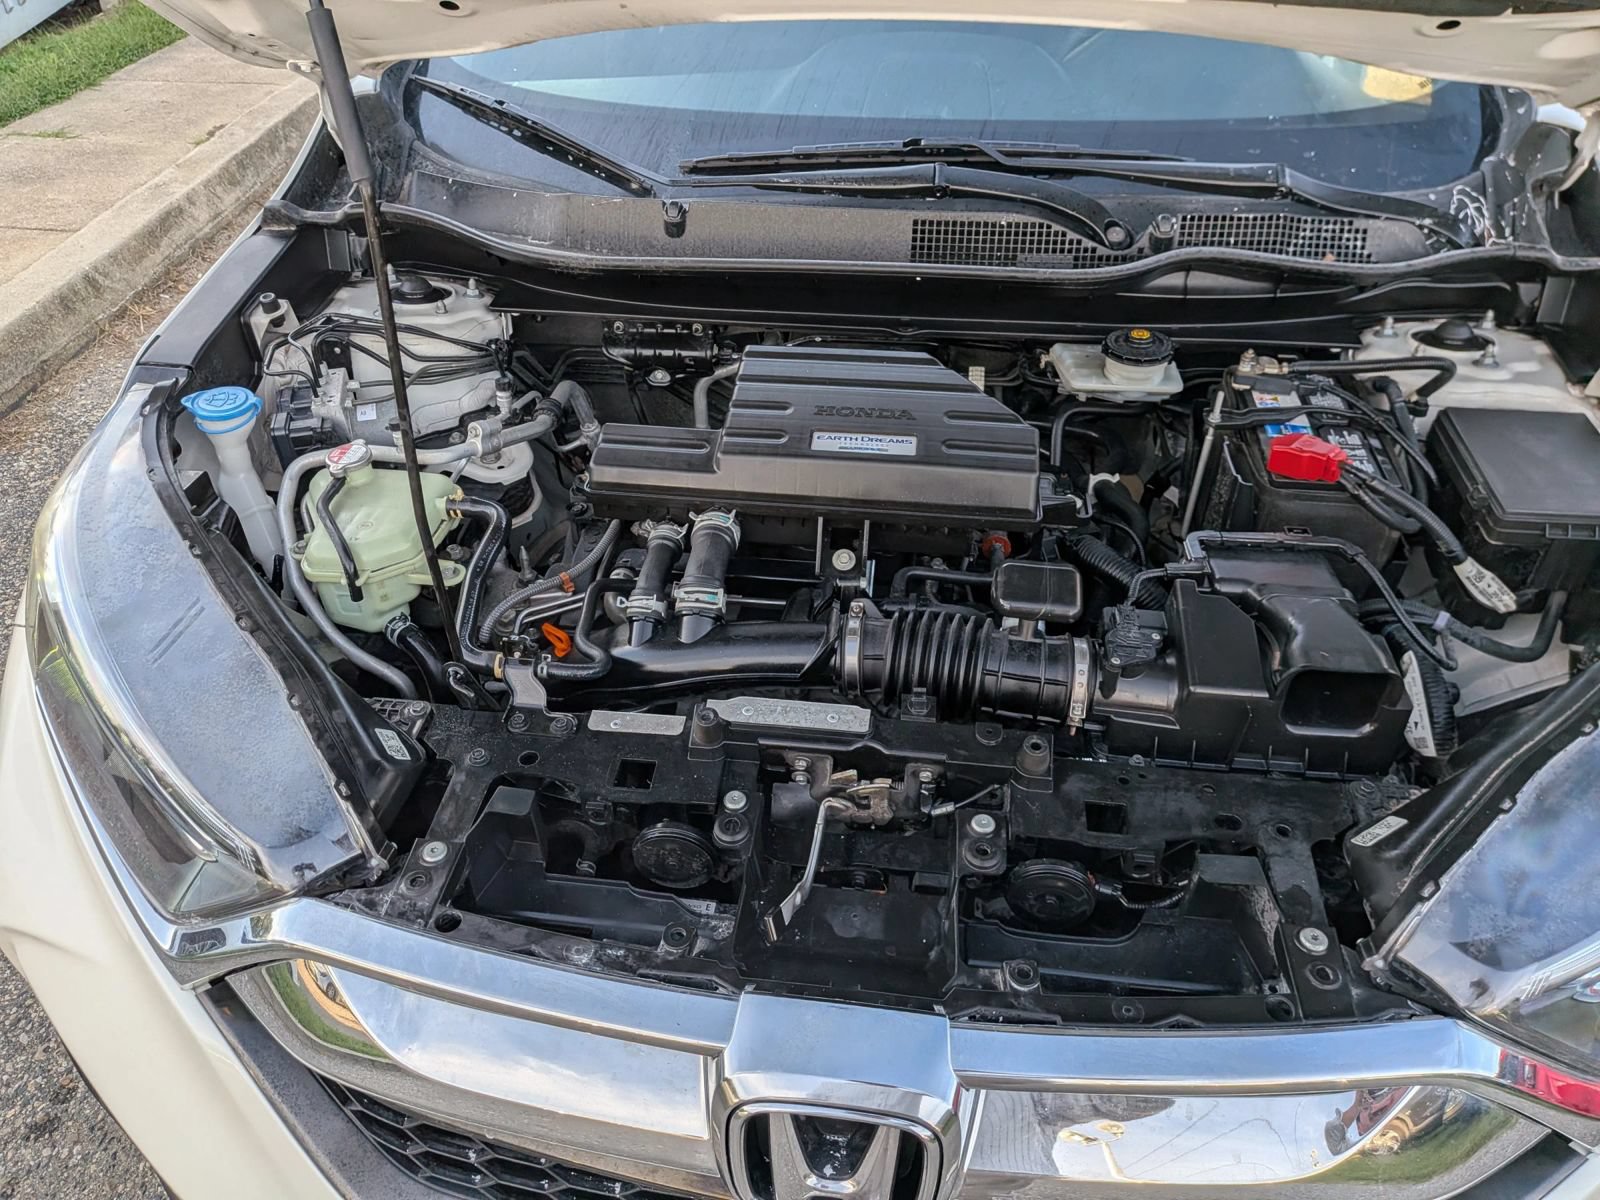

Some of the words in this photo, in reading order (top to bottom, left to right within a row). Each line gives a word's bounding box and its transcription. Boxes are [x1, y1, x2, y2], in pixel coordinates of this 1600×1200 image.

[814, 405, 917, 420] HONDA
[817, 434, 858, 442] EARTH
[861, 436, 913, 445] DREAMS
